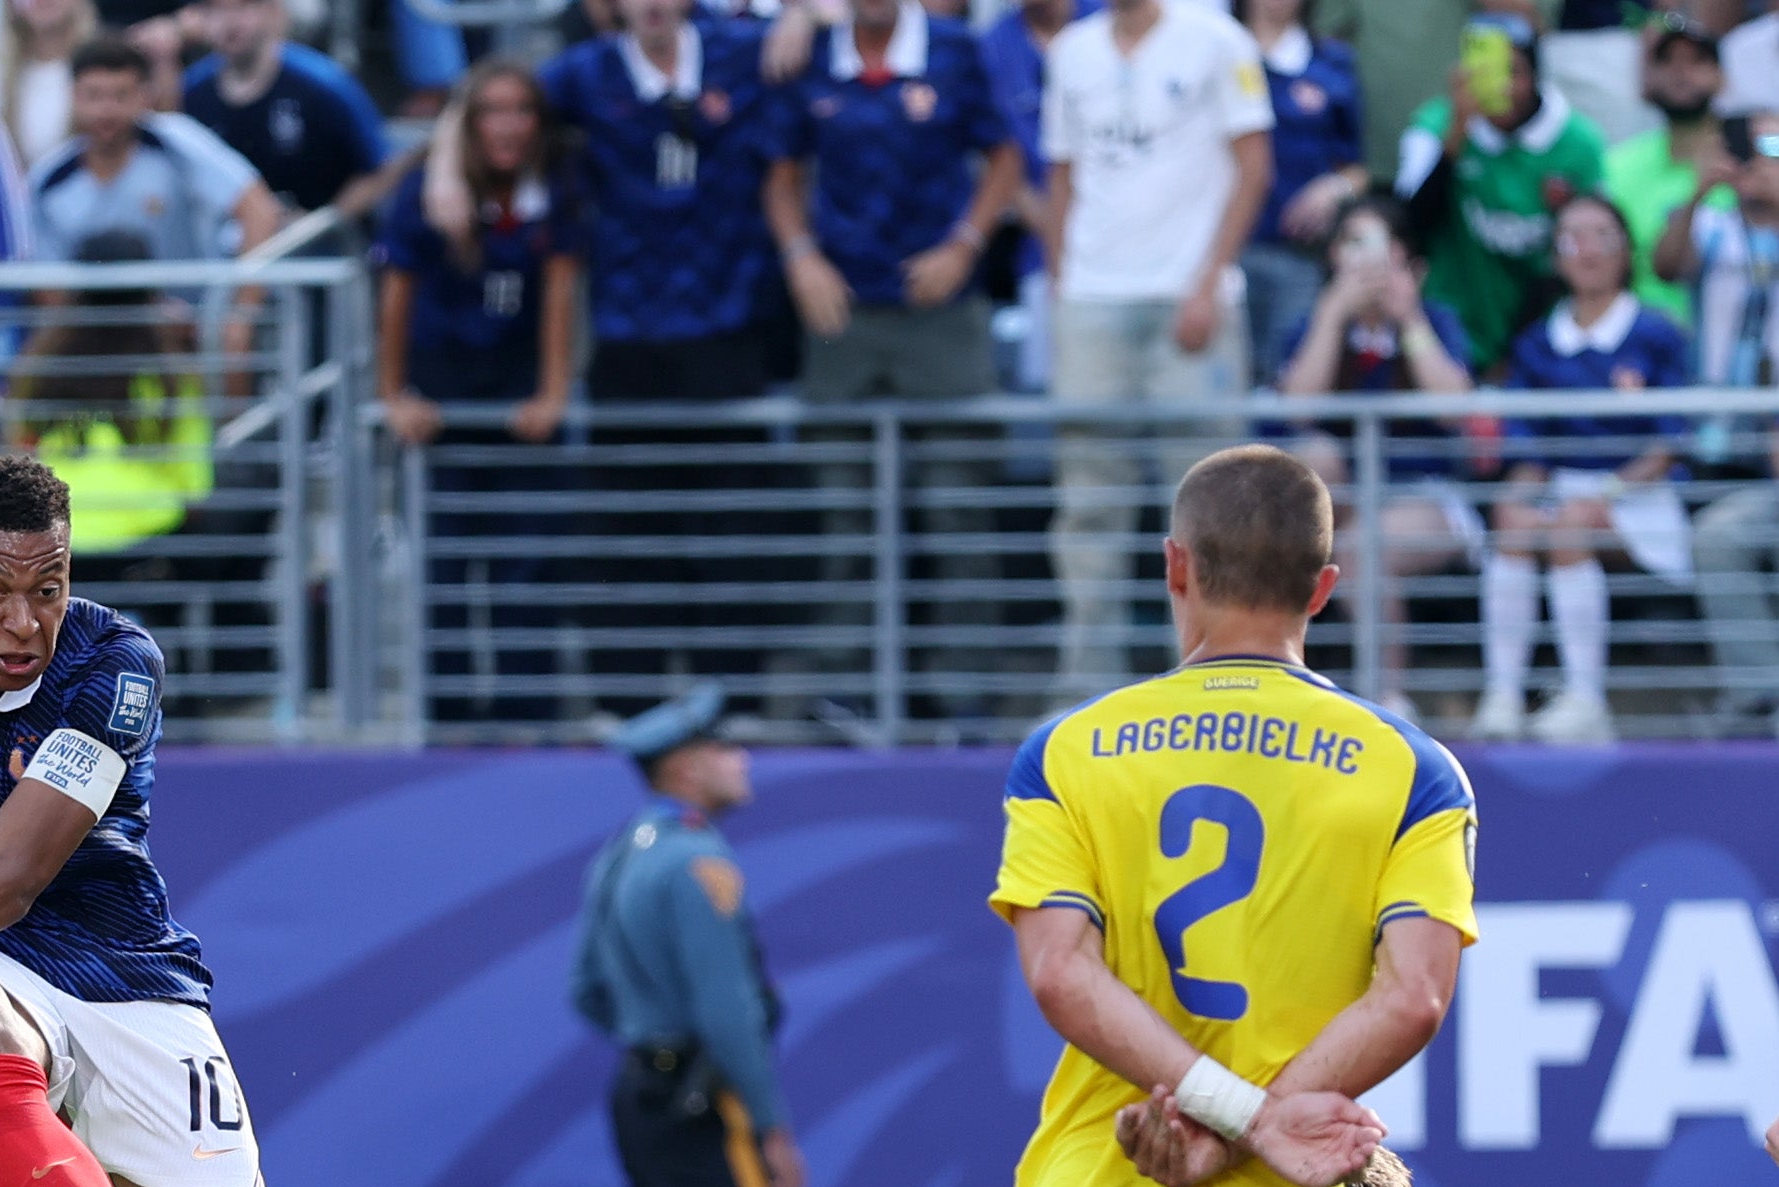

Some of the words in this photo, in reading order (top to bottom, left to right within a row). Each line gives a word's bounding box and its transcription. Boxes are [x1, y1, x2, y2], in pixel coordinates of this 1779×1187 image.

[123, 690, 149, 708] UNITES
[46, 740, 98, 774] UNITES
[56, 731, 103, 760] FOOTBALL
[1091, 711, 1364, 775] LAGERBIELKE
[36, 752, 56, 767] the
[55, 761, 92, 788] World
[1154, 784, 1265, 1022] 2
[179, 1055, 245, 1132] 10
